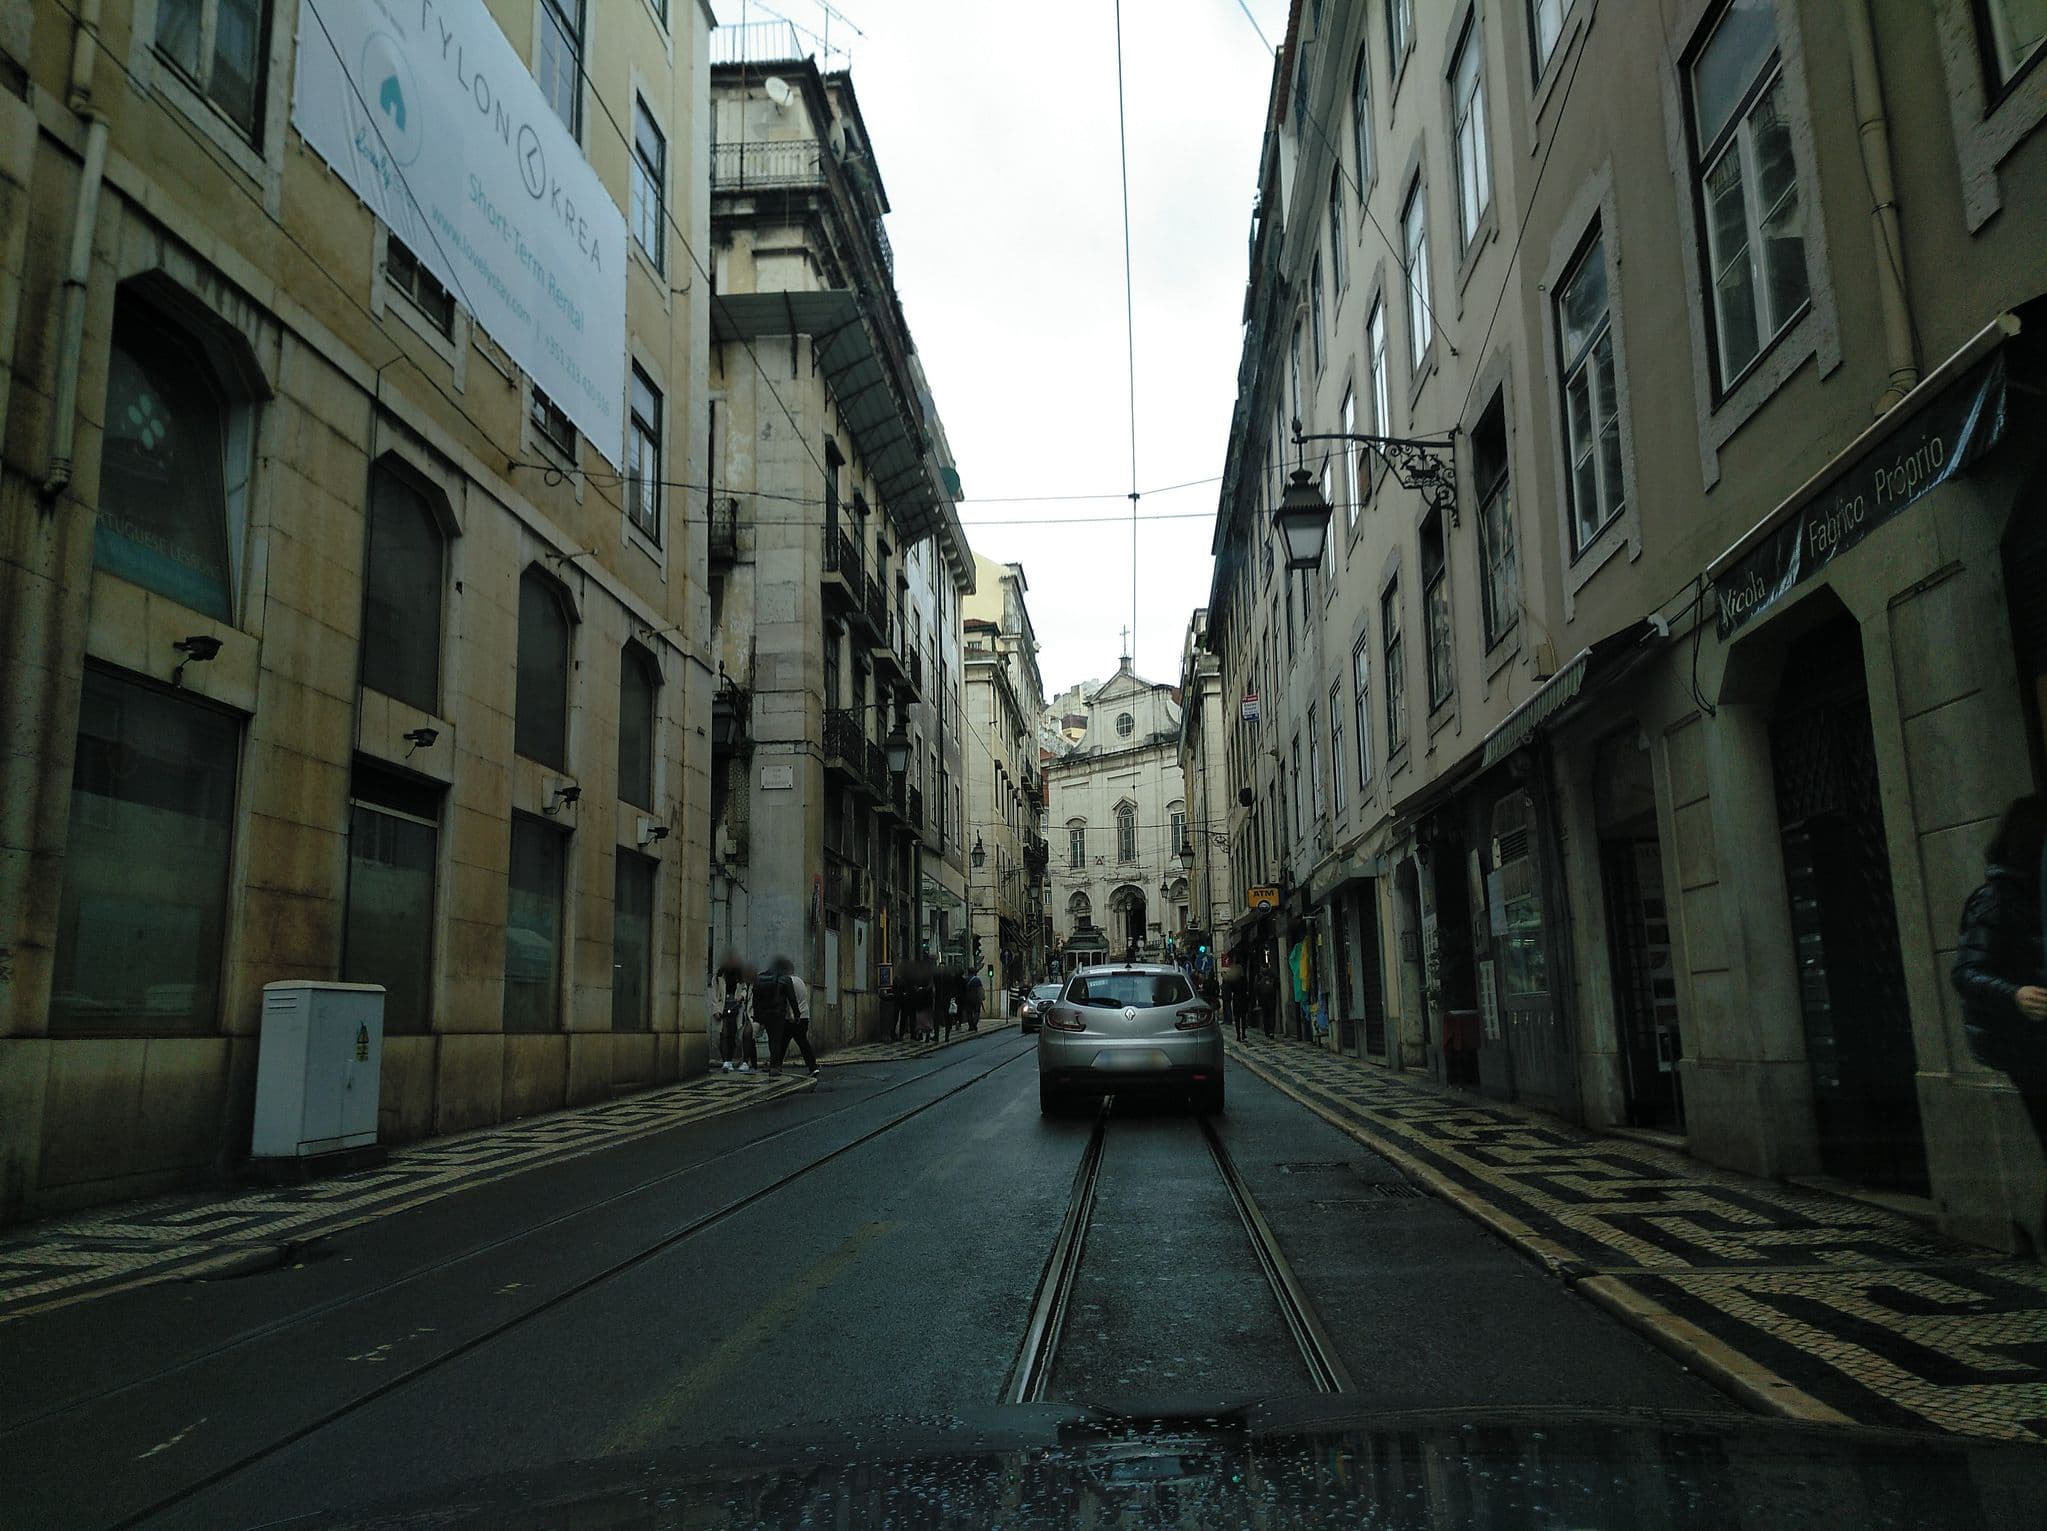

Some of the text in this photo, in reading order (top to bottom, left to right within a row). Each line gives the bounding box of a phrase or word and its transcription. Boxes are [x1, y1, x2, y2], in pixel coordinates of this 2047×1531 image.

[551, 176, 602, 273] KREA
[548, 272, 584, 335] Rental
[1718, 434, 1945, 627] Nicola Fabrico Próprio
[1253, 889, 1274, 898] ATM
